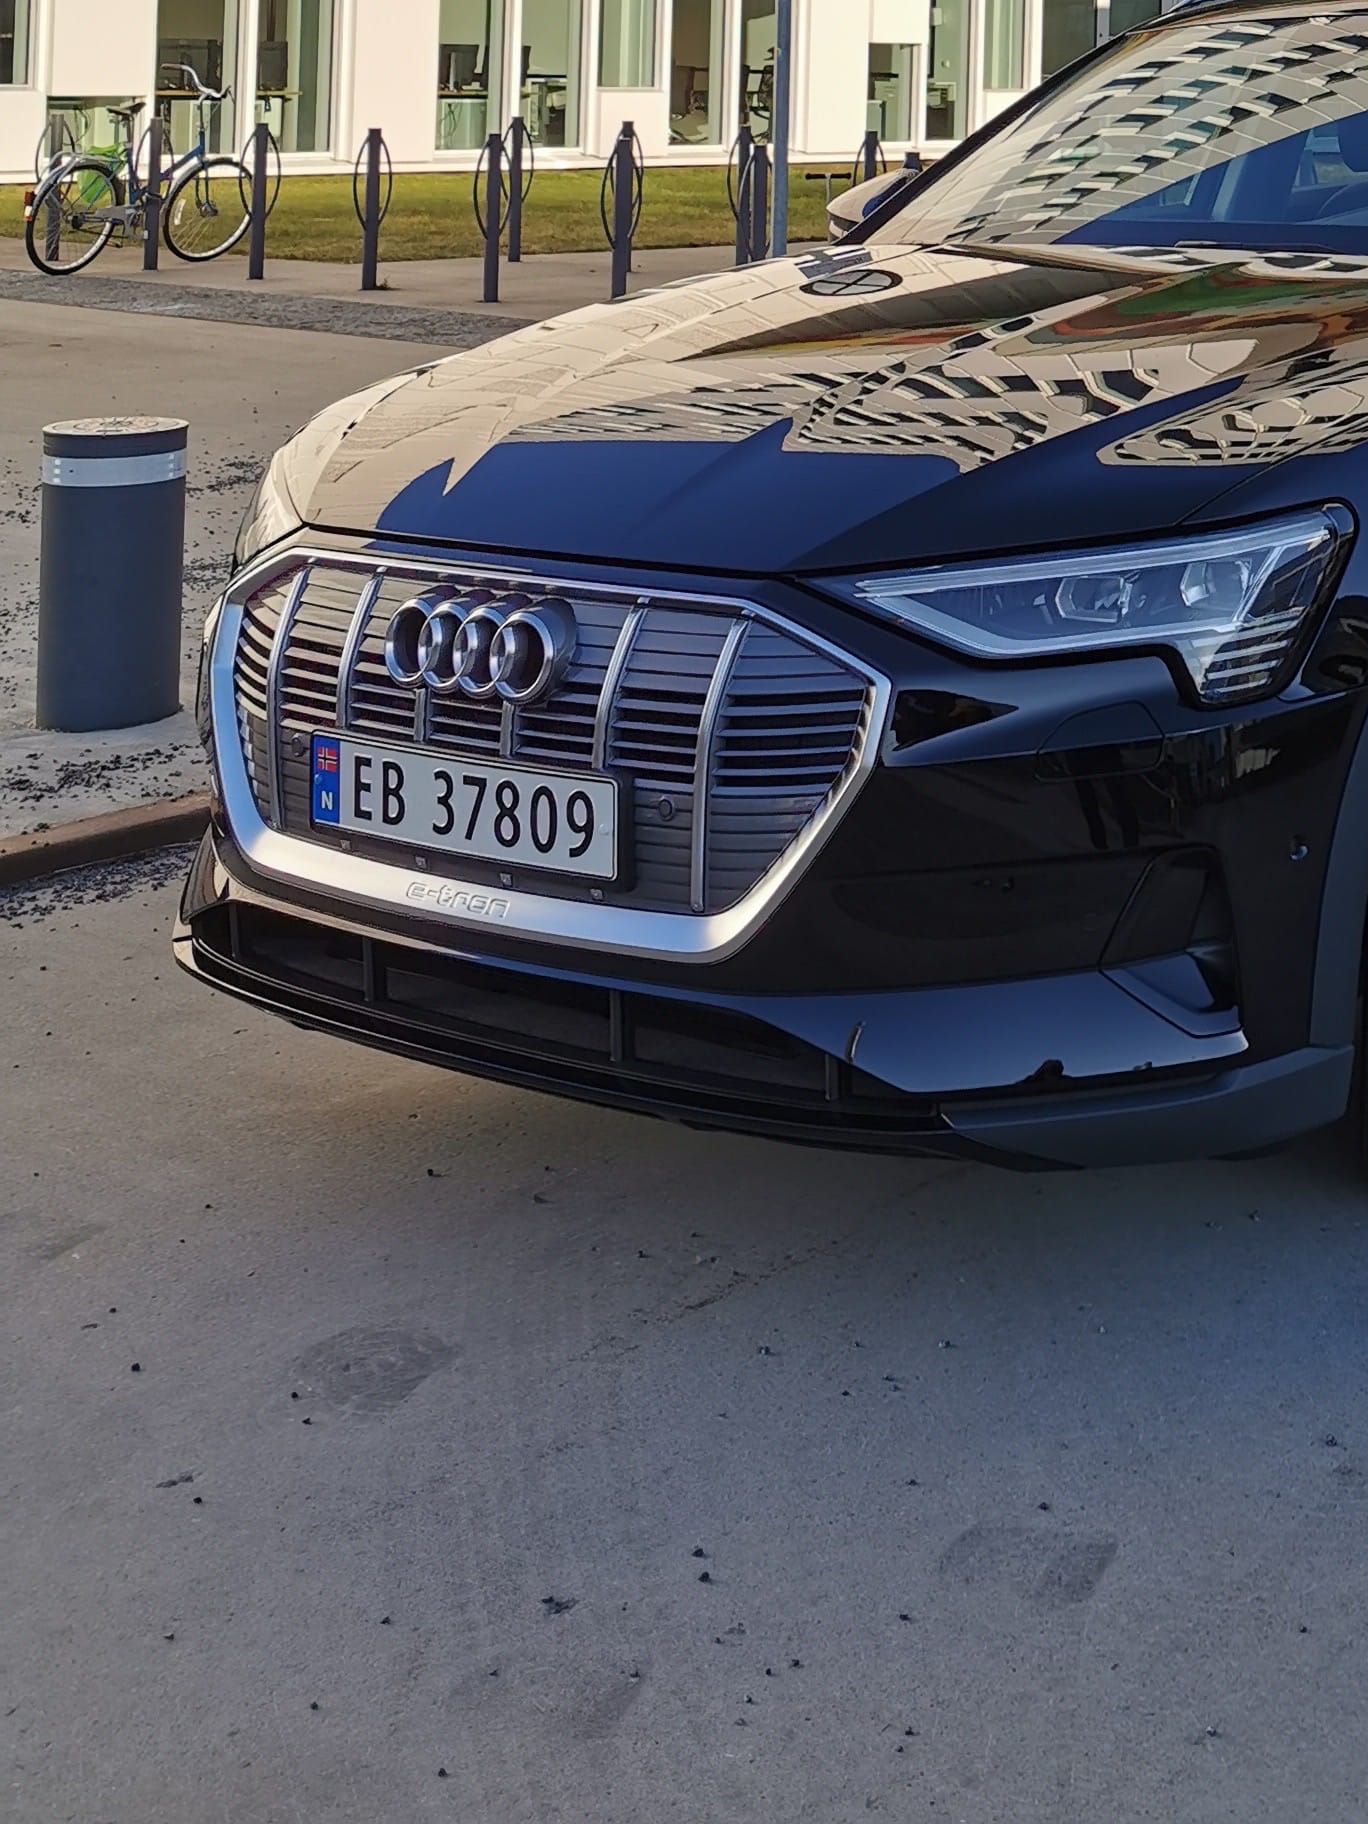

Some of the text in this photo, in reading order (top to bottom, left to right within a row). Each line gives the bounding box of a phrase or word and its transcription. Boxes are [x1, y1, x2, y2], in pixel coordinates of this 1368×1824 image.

[321, 790, 333, 811] N
[353, 756, 595, 858] EB 37809
[406, 881, 511, 918] e-tron
